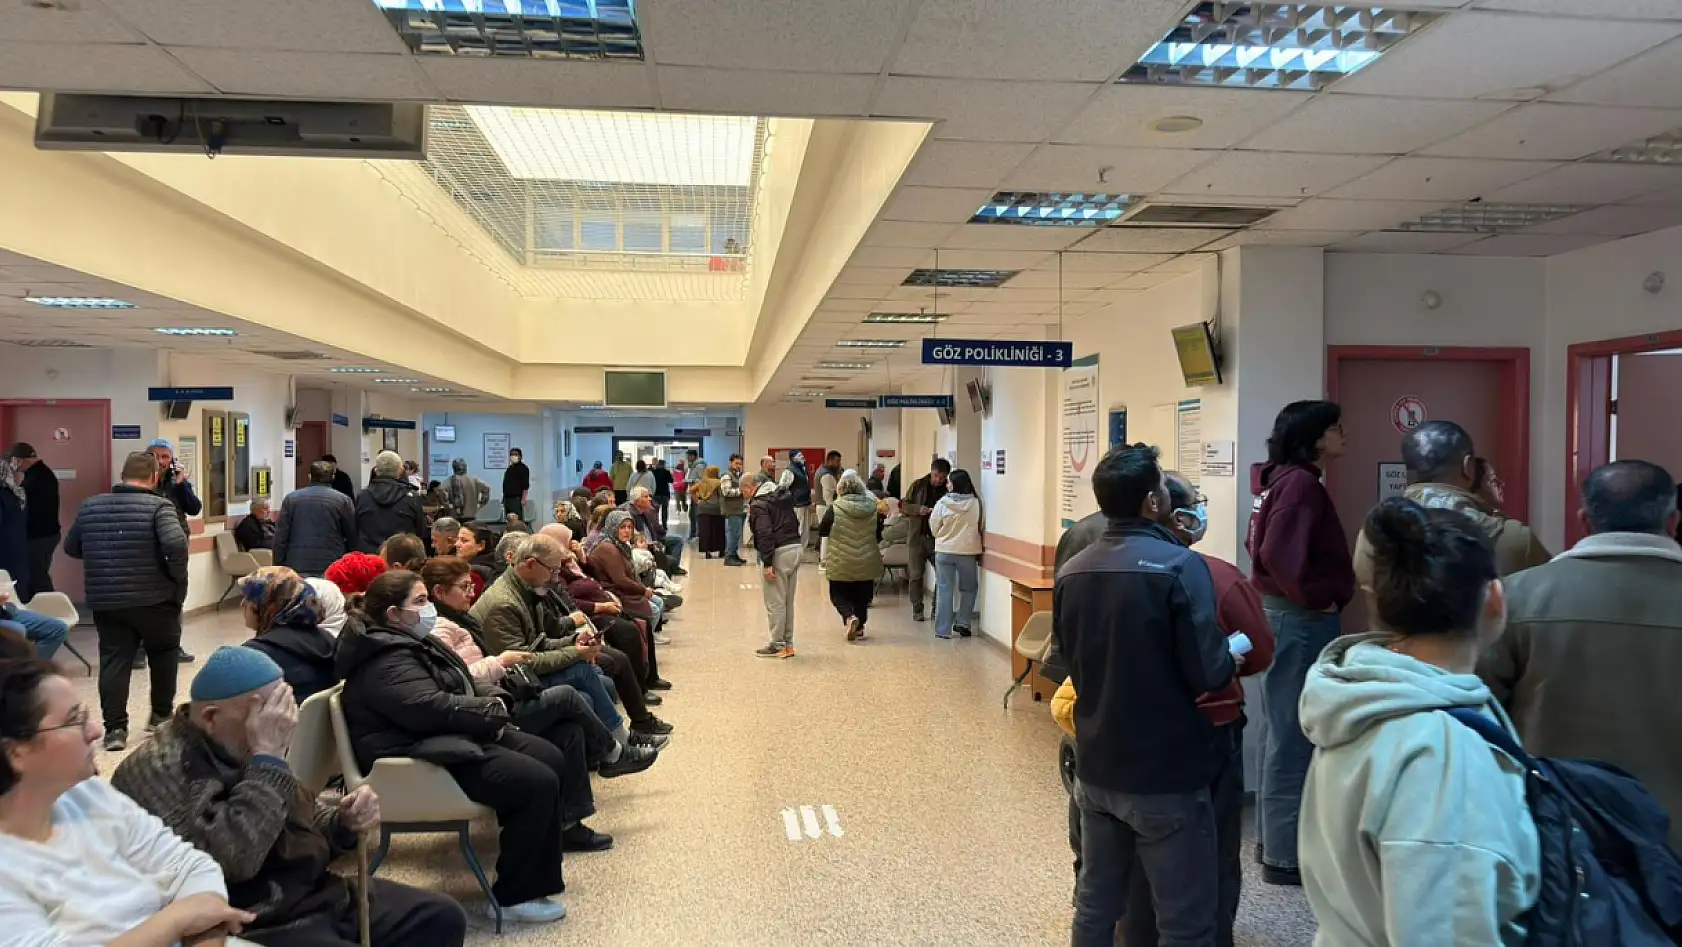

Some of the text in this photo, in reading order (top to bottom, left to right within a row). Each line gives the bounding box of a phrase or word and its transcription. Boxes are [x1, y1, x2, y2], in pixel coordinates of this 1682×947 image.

[933, 344, 961, 360] GÖZ
[965, 345, 1044, 361] POLİKLİNİĞİ
[1055, 349, 1063, 361] 3
